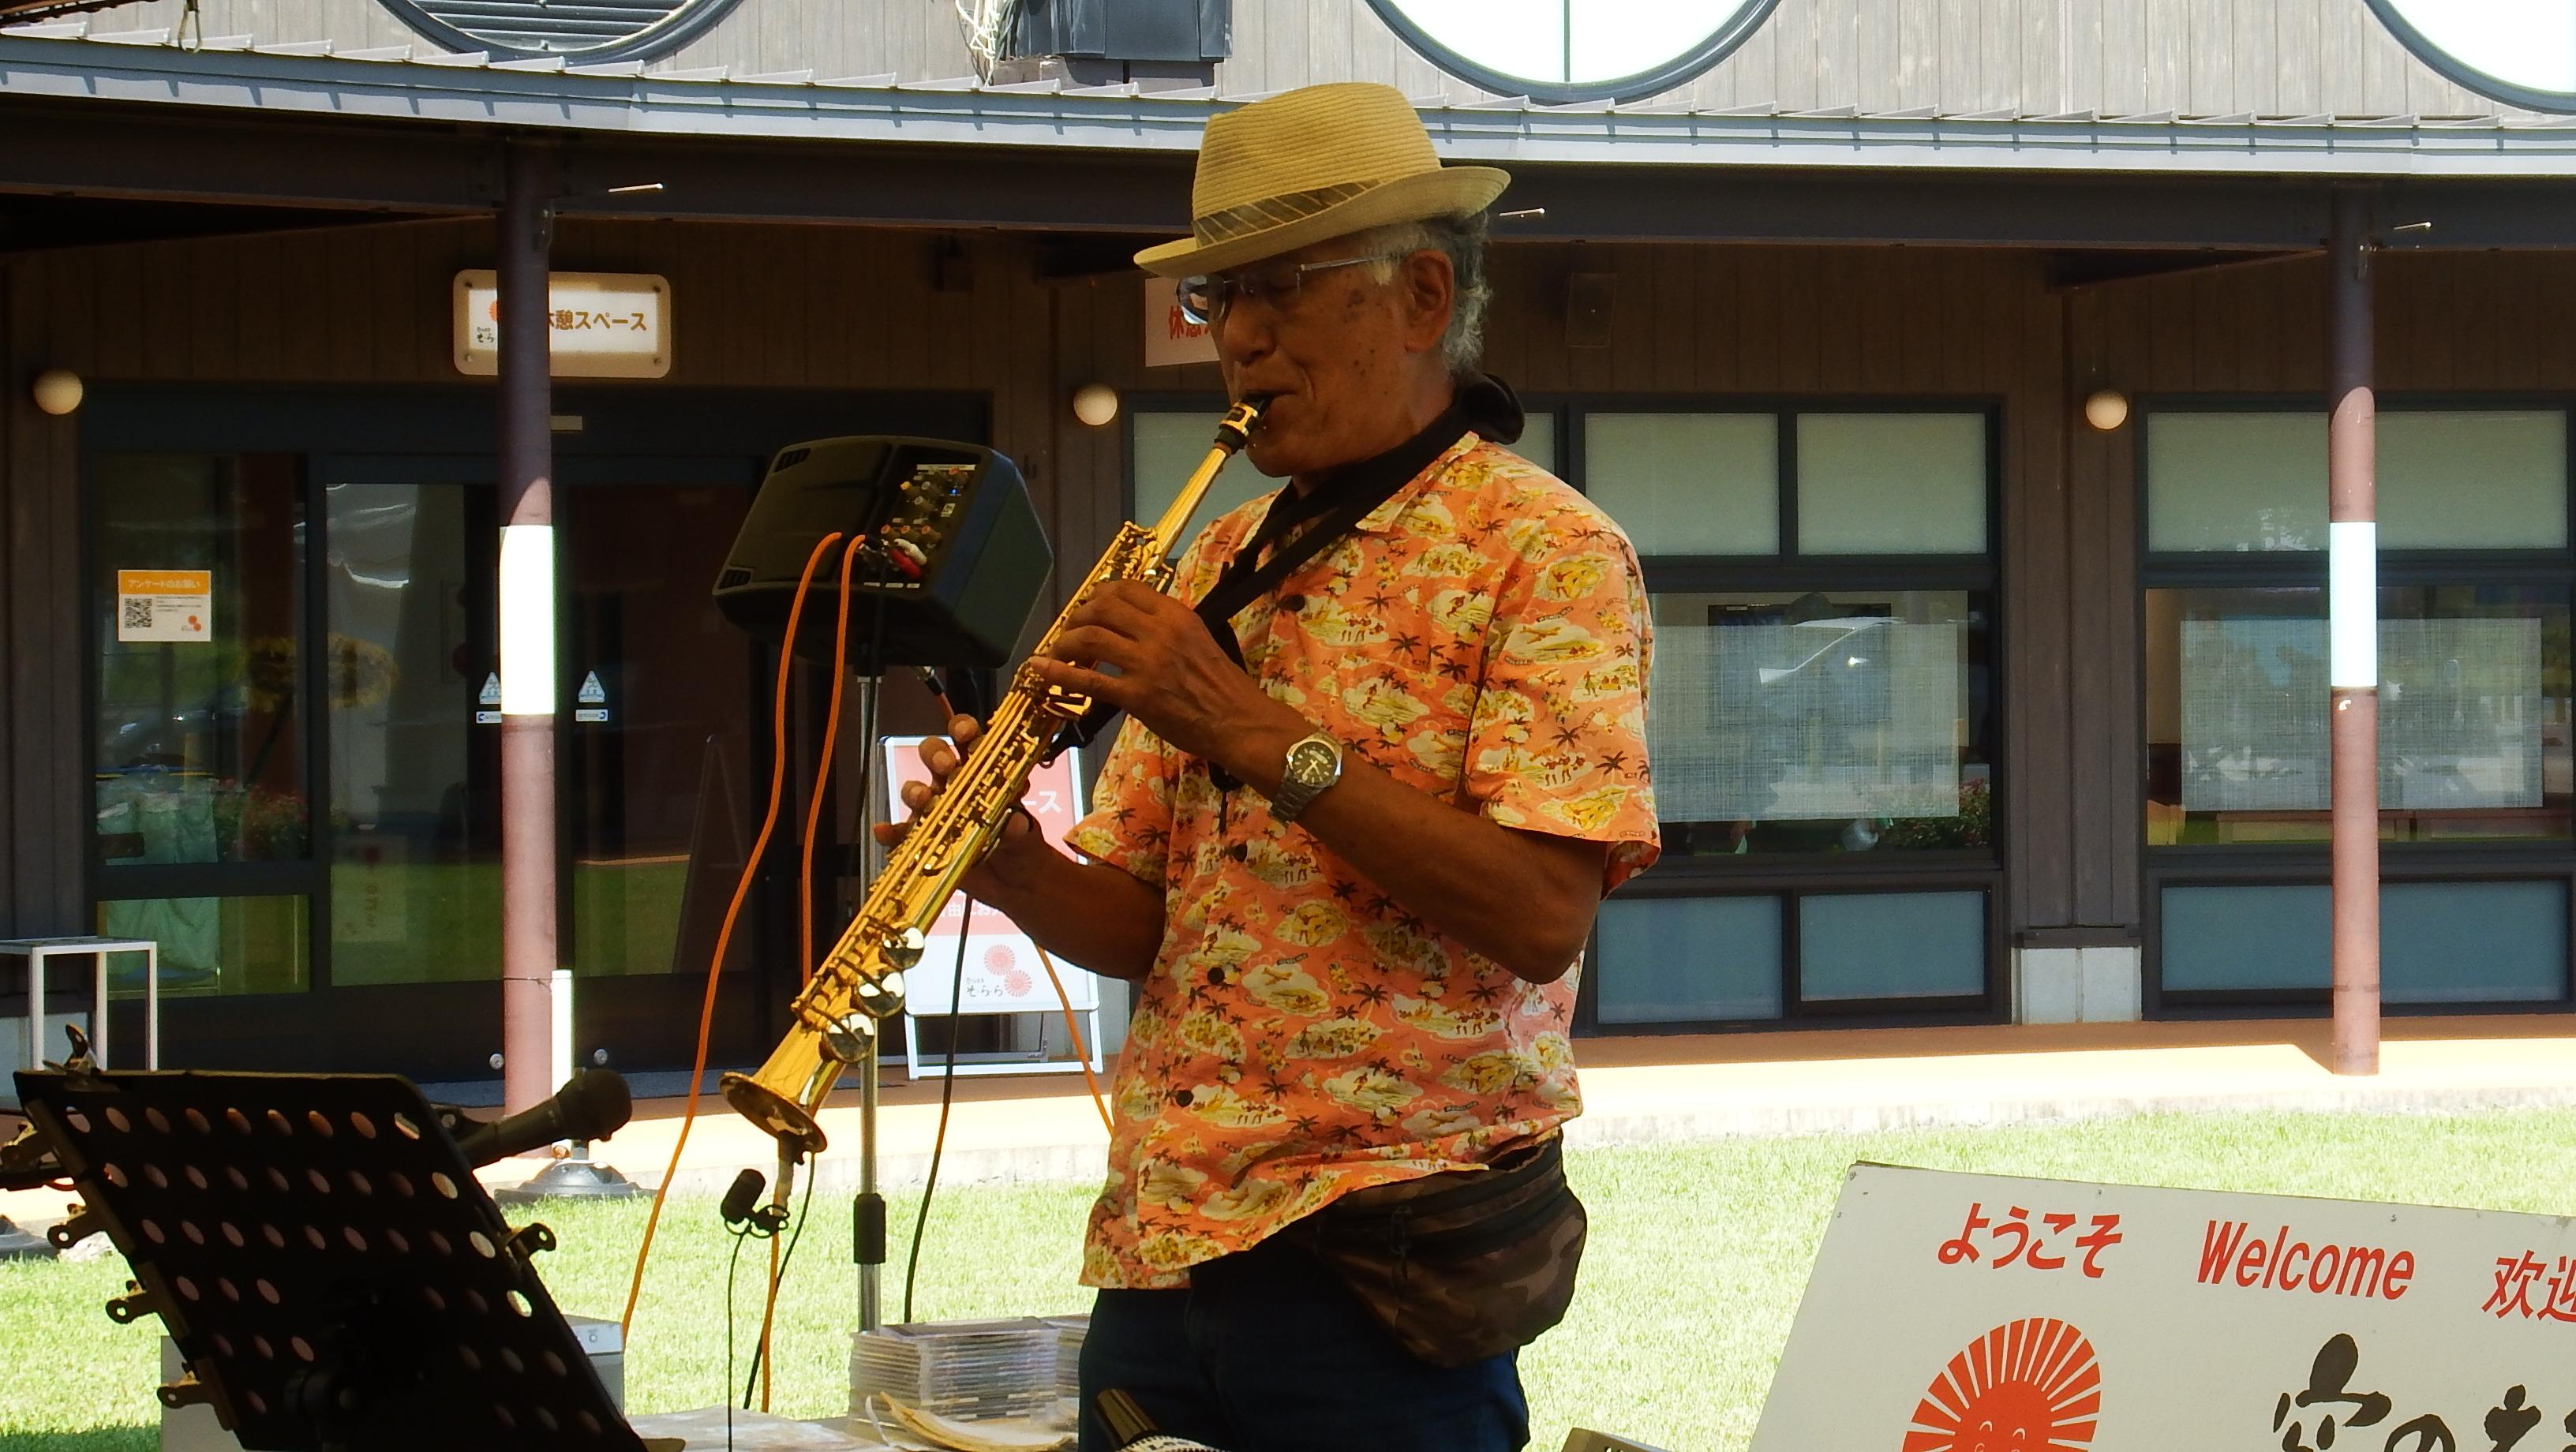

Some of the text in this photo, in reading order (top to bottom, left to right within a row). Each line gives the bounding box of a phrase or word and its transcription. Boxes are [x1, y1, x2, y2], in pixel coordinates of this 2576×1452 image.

[1937, 1203, 2122, 1278] ようこそ
[2197, 1221, 2415, 1300] Welcome
